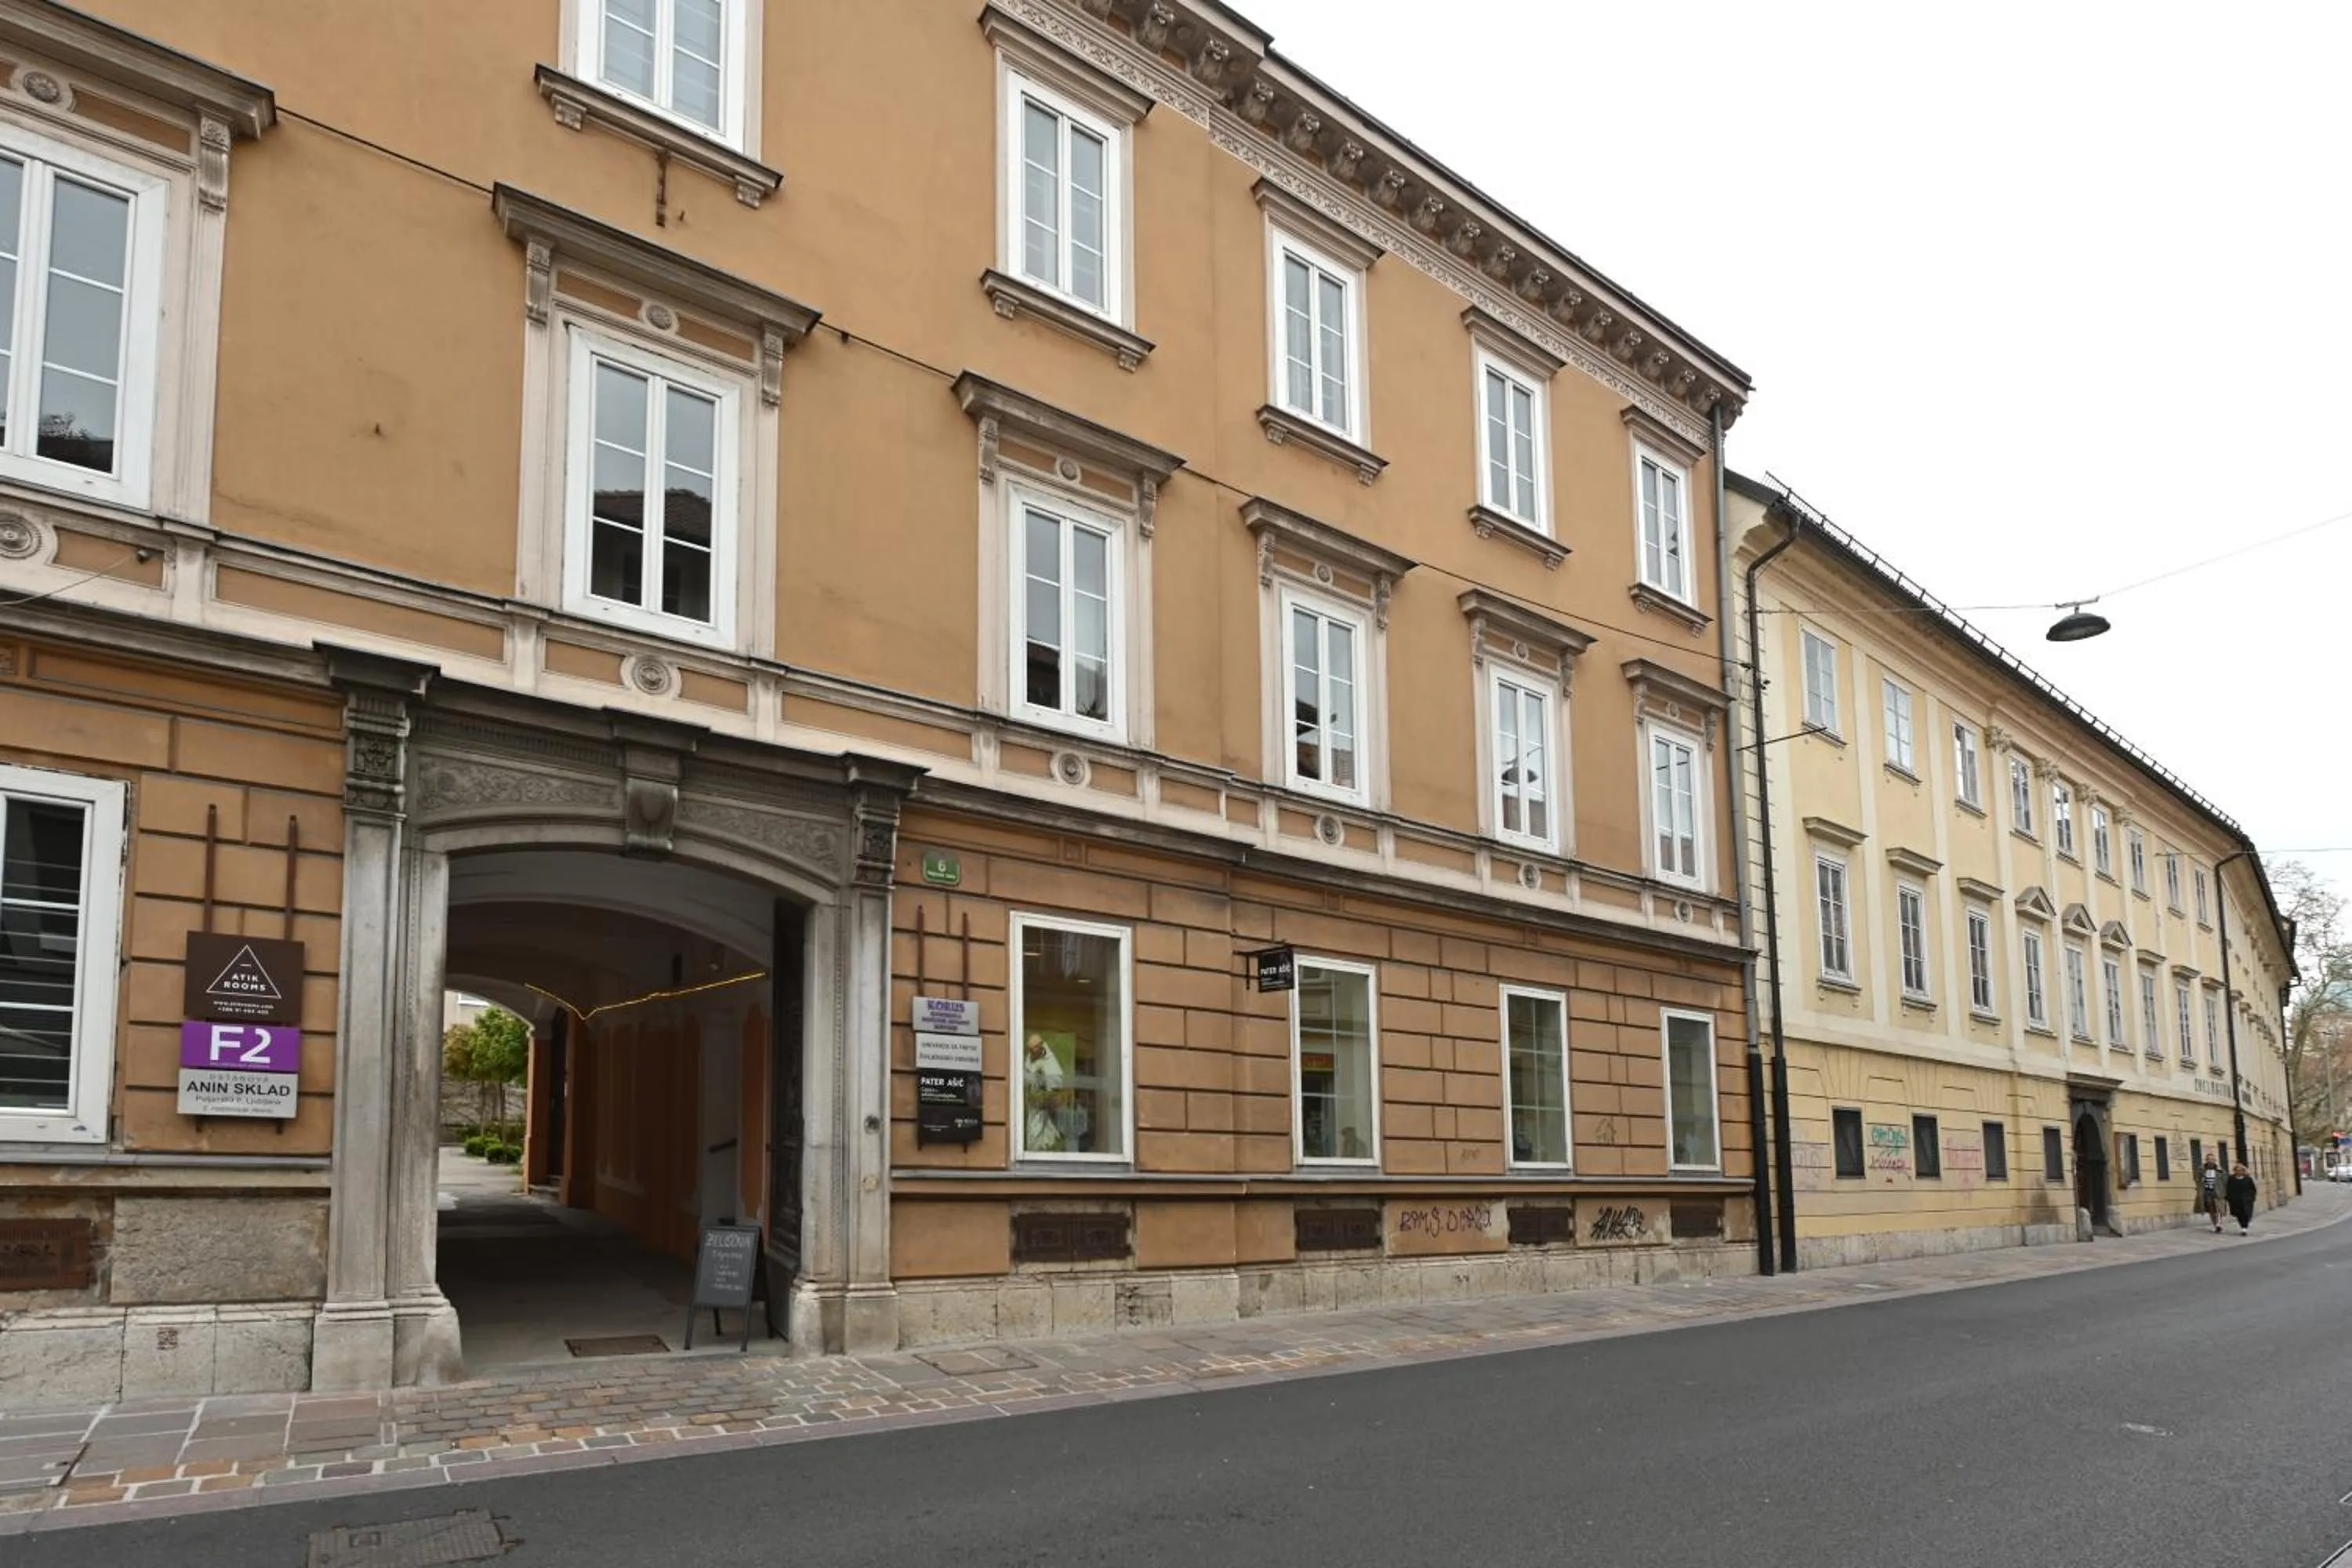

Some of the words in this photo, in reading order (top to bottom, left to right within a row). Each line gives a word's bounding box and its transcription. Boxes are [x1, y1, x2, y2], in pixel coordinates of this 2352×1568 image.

[938, 859, 946, 872] 6
[231, 972, 258, 982] ATIK
[223, 981, 267, 992] ROOMS
[209, 1025, 272, 1064] F2
[920, 1076, 945, 1086] PATER
[186, 1081, 229, 1094] ANIN
[234, 1083, 291, 1097] SKLAD
